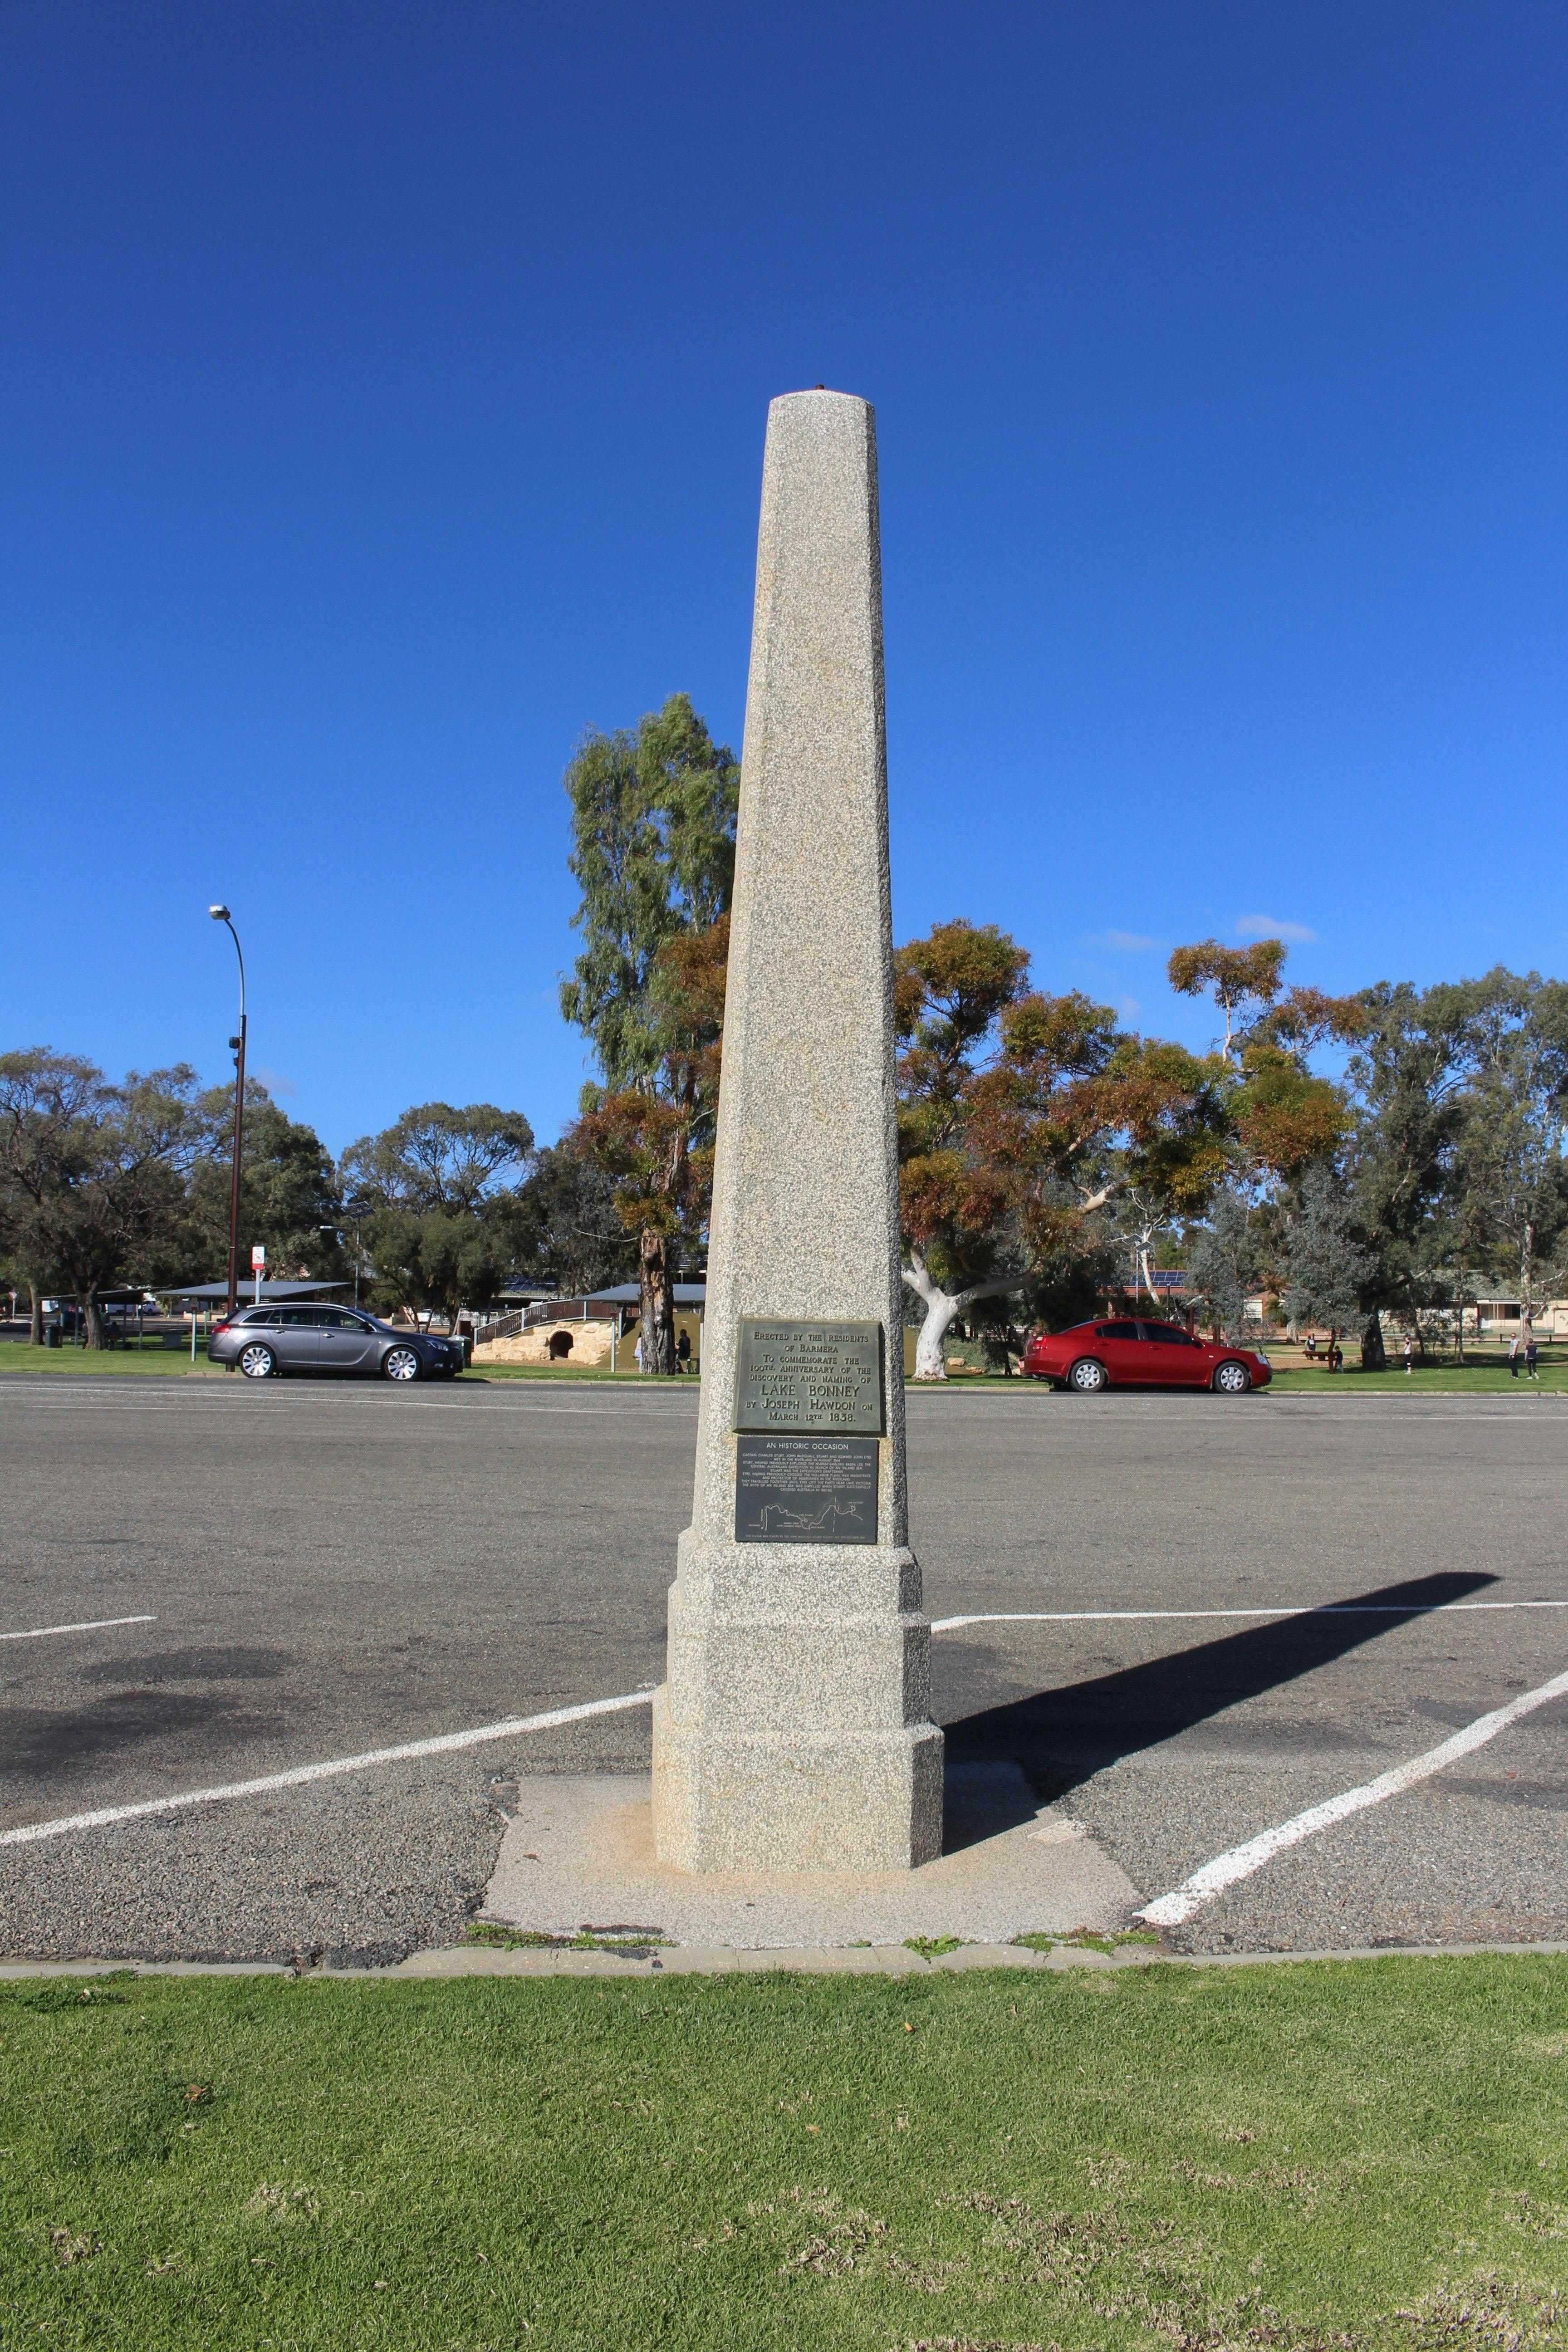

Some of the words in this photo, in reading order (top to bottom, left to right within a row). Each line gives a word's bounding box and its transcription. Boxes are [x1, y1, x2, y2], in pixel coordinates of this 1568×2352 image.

[754, 1332, 789, 1340] ERECTED
[799, 1344, 838, 1353] BARMERA
[763, 1354, 774, 1362] TO
[761, 1385, 795, 1396] LAKE
[808, 1386, 860, 1396] BONNEY
[762, 1398, 799, 1409] JOSEPH
[810, 1399, 855, 1410] HAWDON
[769, 1412, 798, 1421] MARCH
